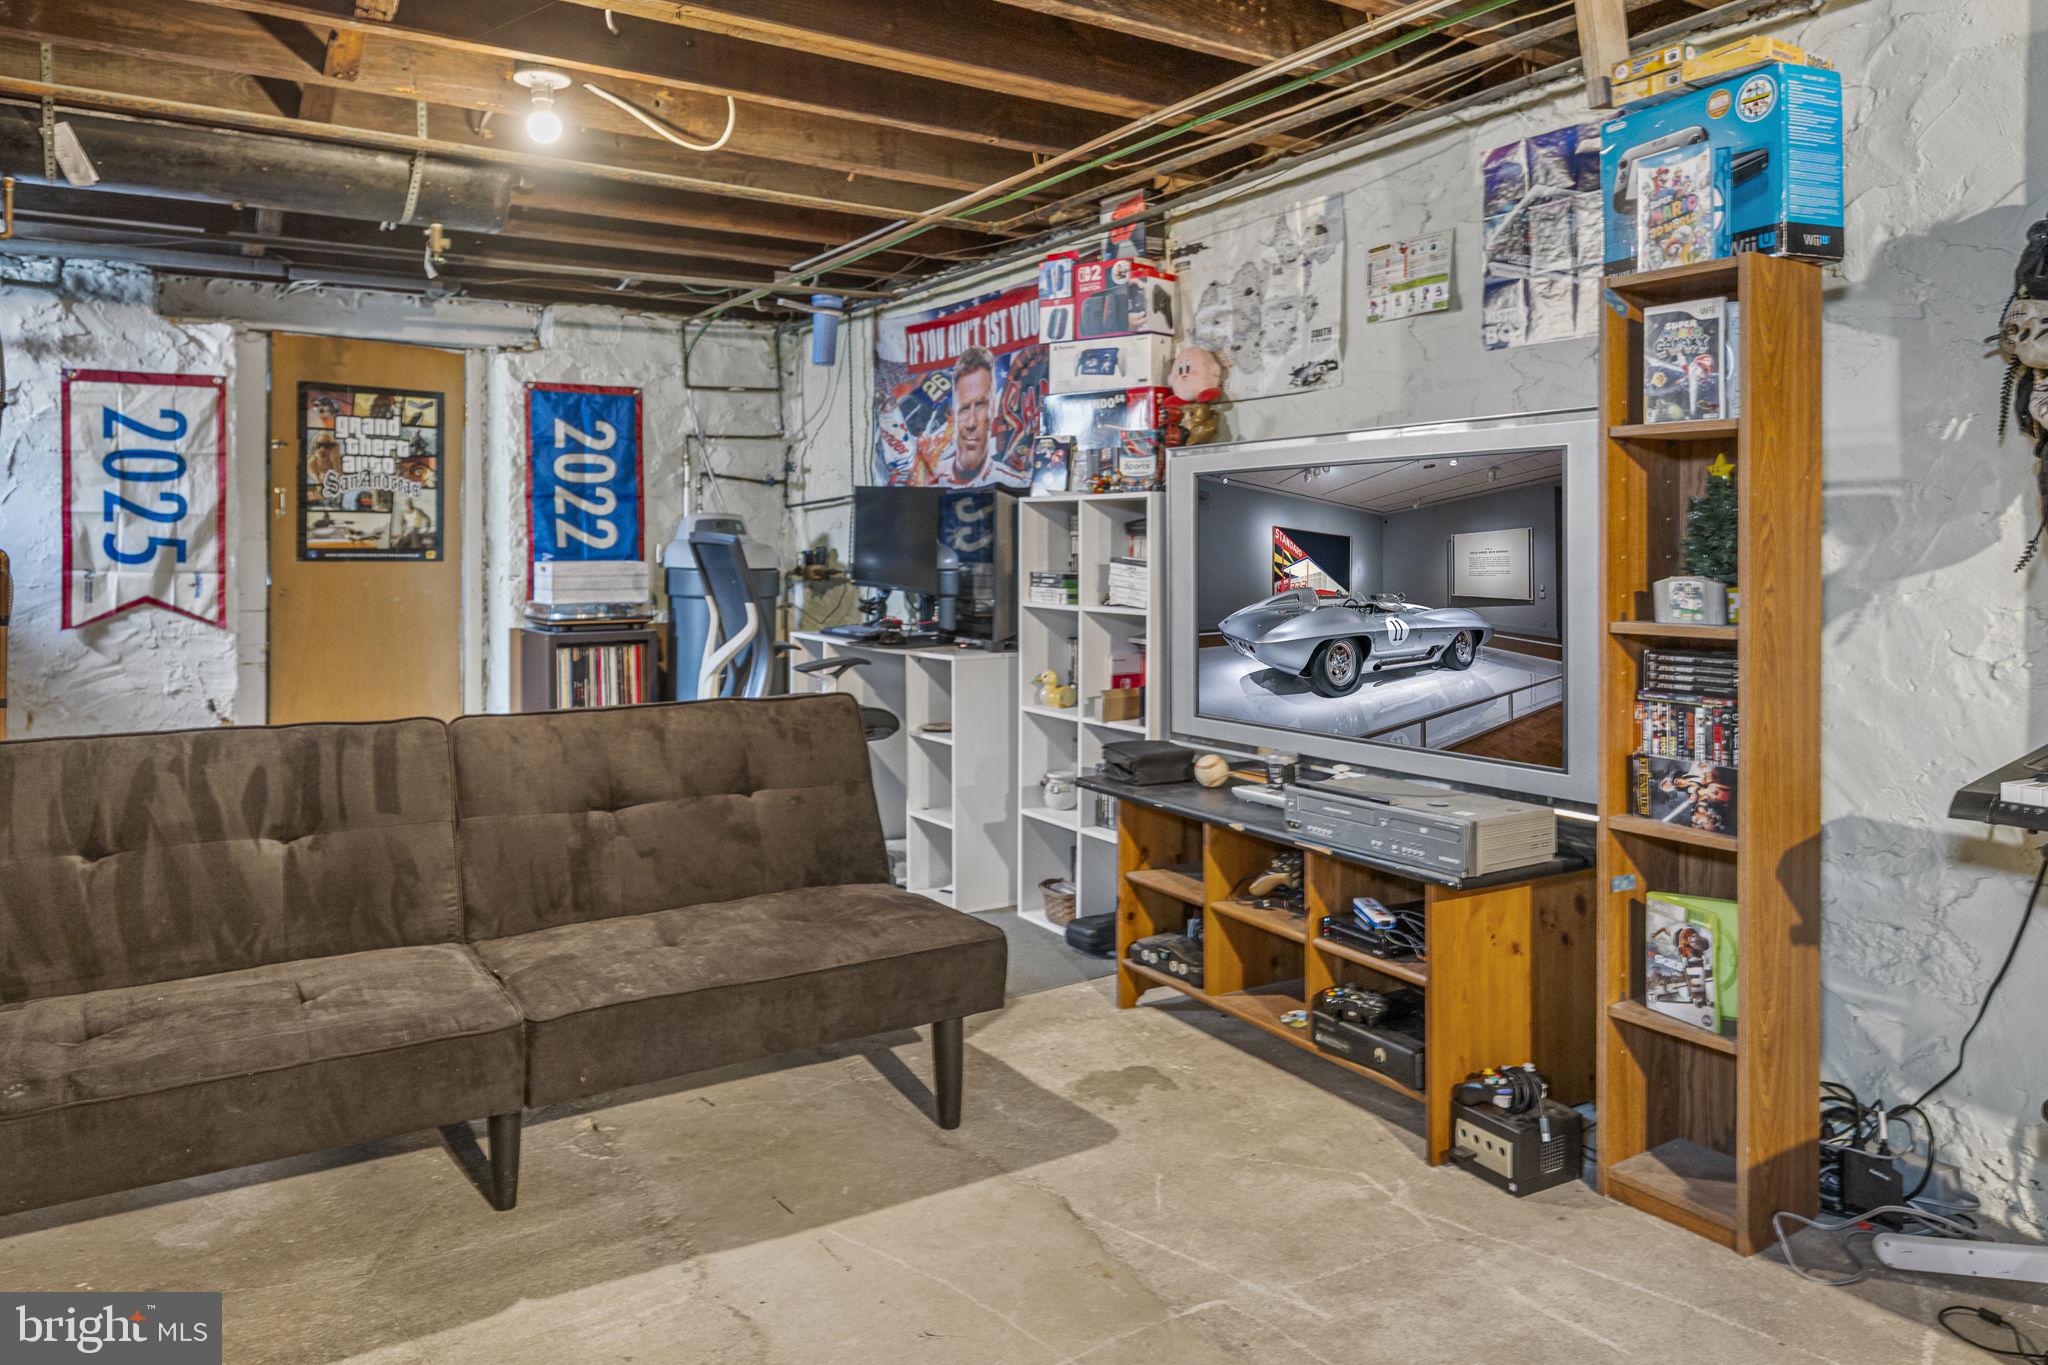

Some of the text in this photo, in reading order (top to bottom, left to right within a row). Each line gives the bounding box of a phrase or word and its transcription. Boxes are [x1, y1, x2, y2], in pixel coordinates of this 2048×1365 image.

[1648, 194, 1698, 227] MARIO
[908, 299, 1040, 365] IF YOU AIN'T 1ST YOU
[1311, 327, 1333, 338] SOUTH
[921, 373, 952, 402] 26
[336, 415, 400, 438] grand
[345, 434, 410, 457] theft
[342, 455, 396, 474] auto
[102, 406, 187, 565] 2025
[553, 418, 618, 549] 2022
[1275, 528, 1303, 557] STANDARD
[1389, 619, 1403, 641] 11
